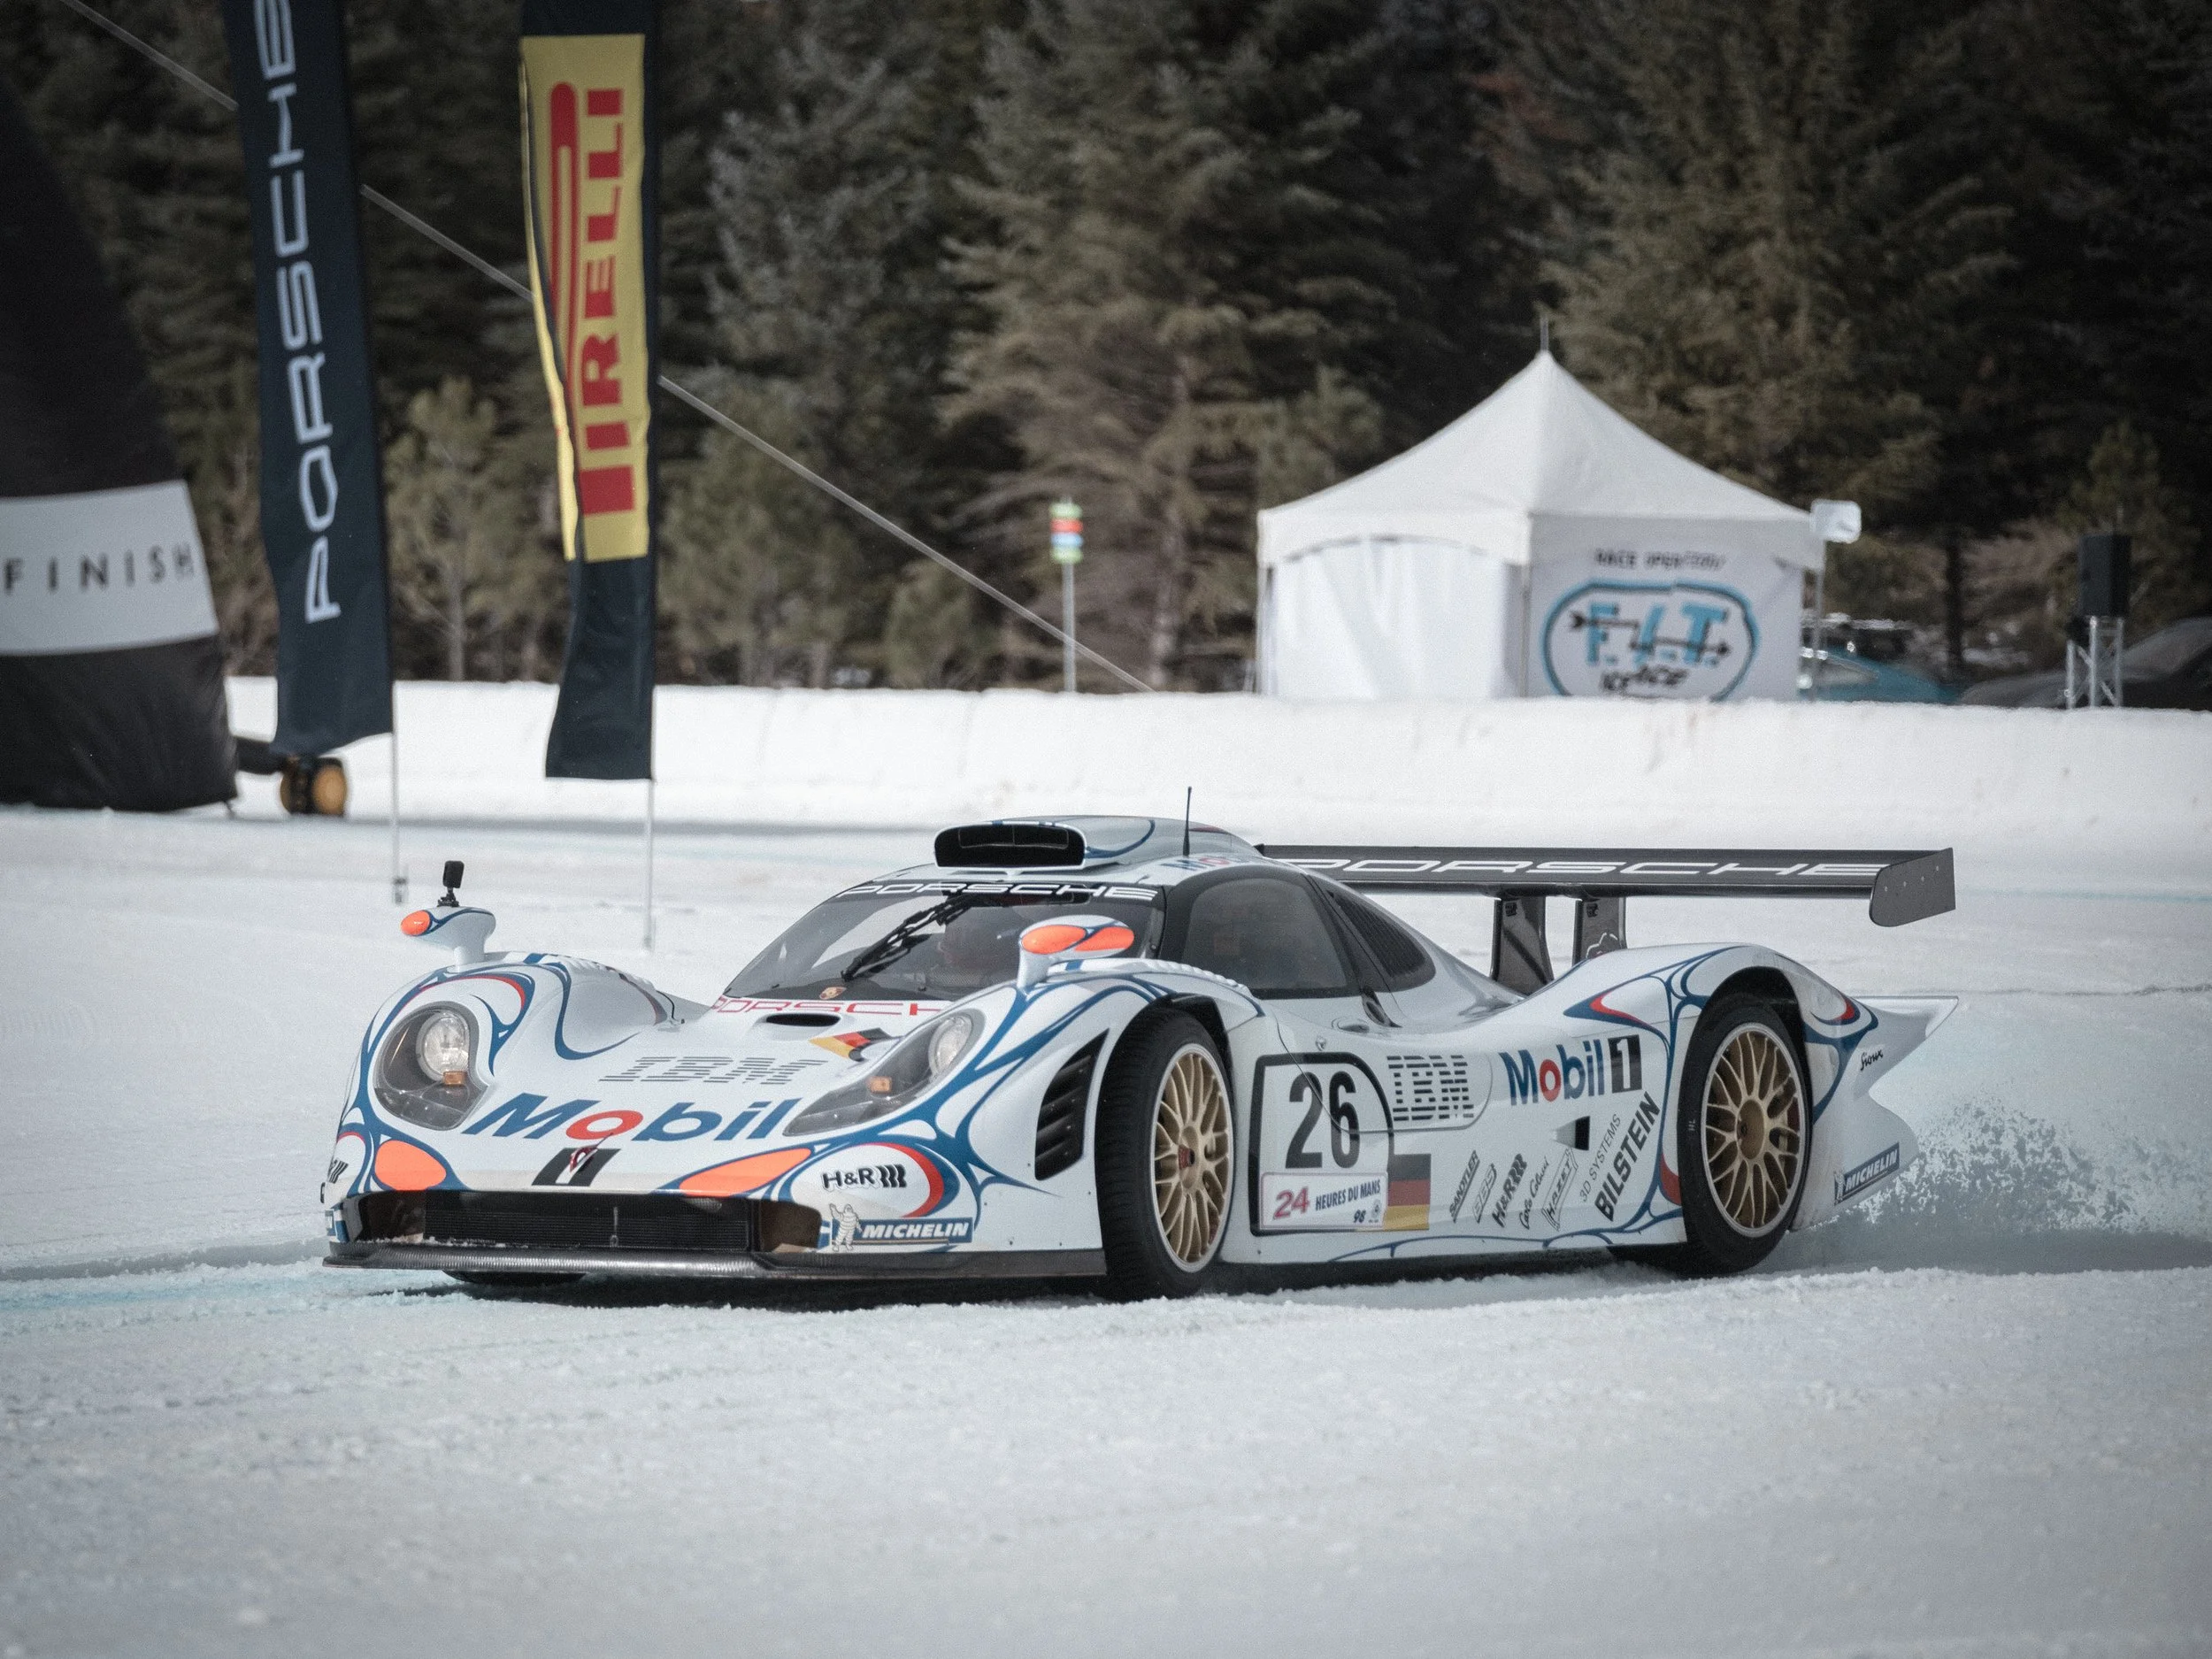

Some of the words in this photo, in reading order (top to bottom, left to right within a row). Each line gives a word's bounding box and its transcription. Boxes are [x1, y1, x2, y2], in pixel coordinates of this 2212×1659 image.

[254, 0, 342, 624] PORSCHE
[550, 81, 636, 517] PIRELLI
[4, 542, 196, 595] FINISH
[837, 883, 1158, 902] PORSCHE
[1275, 858, 1891, 877] PORSCHE
[599, 1056, 830, 1086] IBM
[1498, 1039, 1606, 1106] Mobil
[1860, 1049, 1884, 1071] Sioux
[1386, 1055, 1474, 1122] IBM
[461, 1092, 803, 1142] Mobil
[1285, 1071, 1361, 1170] 26
[822, 1168, 876, 1189] H&R
[1579, 1180, 1593, 1202] 3D
[1588, 1113, 1623, 1181] SYSTEMS
[1594, 1091, 1662, 1222] BILSTEIN
[1845, 1149, 1898, 1193] MICHELIN
[1272, 1186, 1310, 1220] 24
[1315, 1188, 1347, 1211] HEURES
[1348, 1185, 1360, 1202] DU
[1360, 1179, 1381, 1200] MANS
[861, 1222, 970, 1239] MICHELIN
